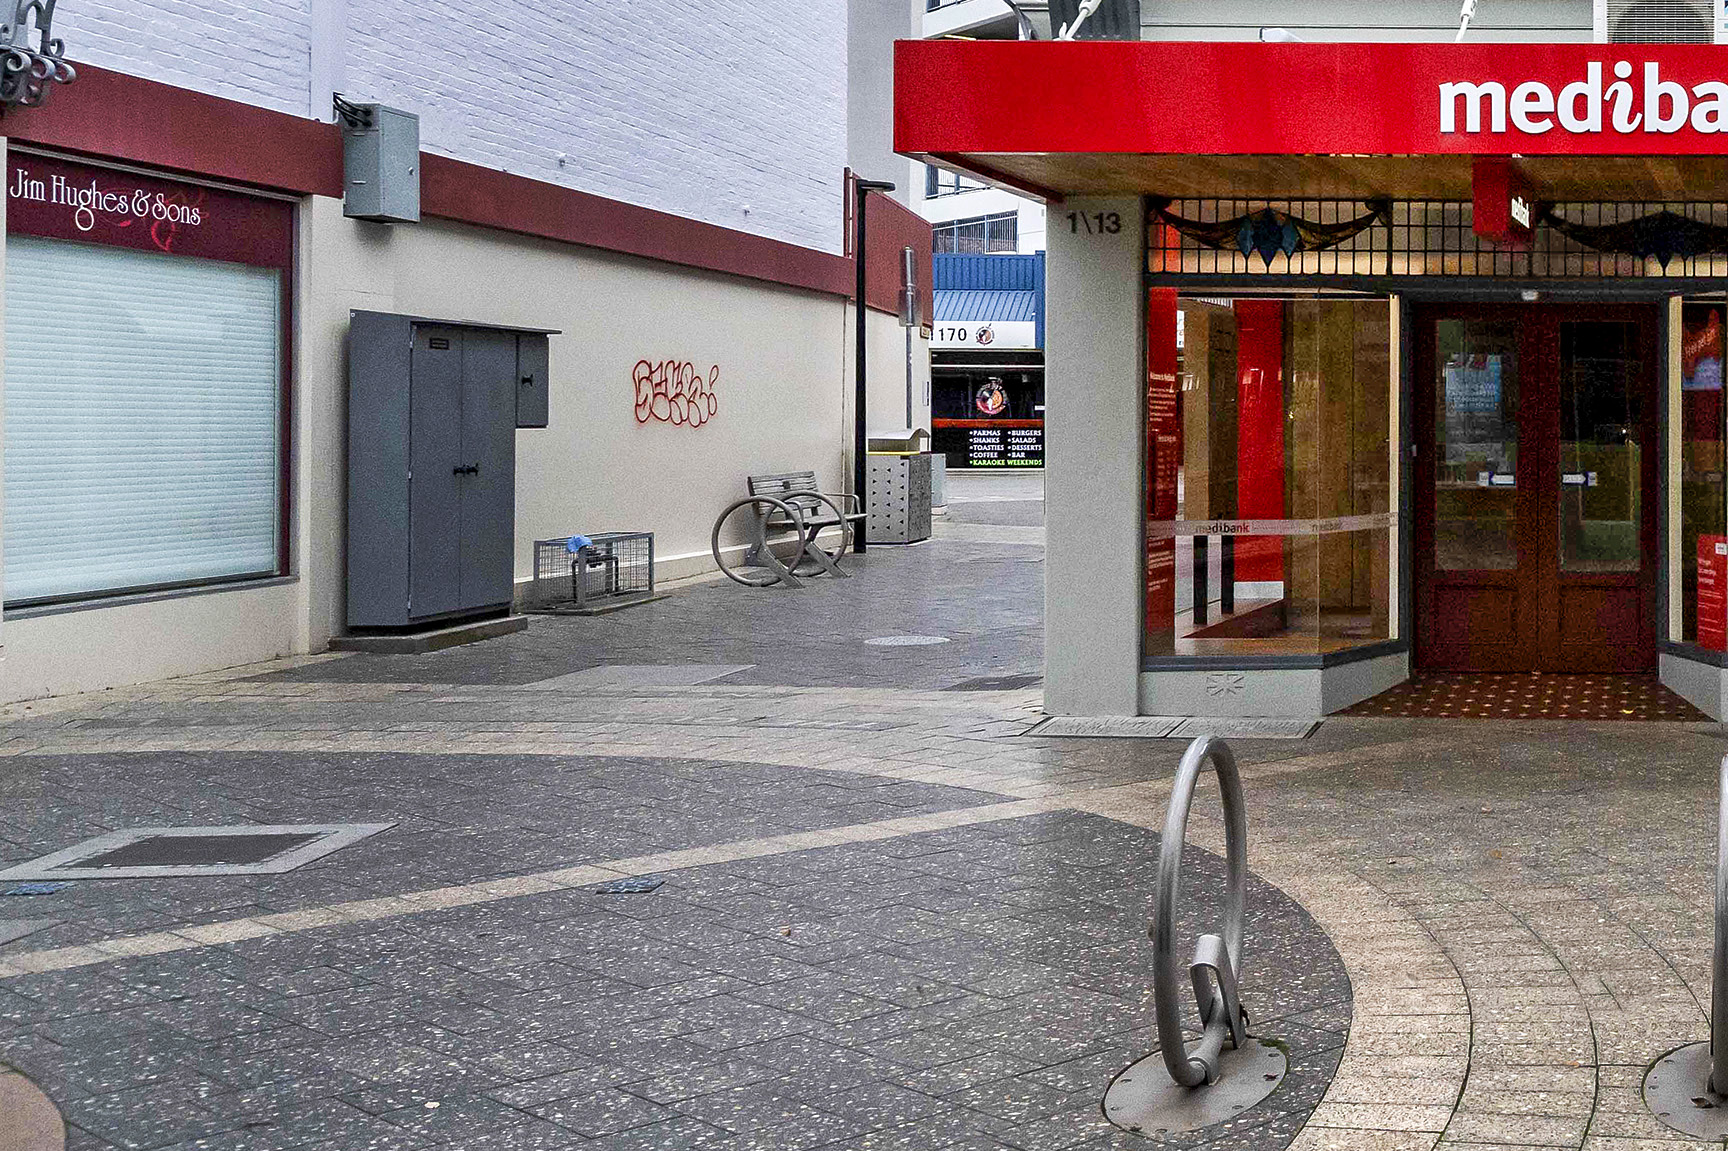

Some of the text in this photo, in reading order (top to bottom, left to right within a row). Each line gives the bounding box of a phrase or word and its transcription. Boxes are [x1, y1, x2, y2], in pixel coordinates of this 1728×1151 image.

[10, 168, 201, 231] Jim Hughes & Sons
